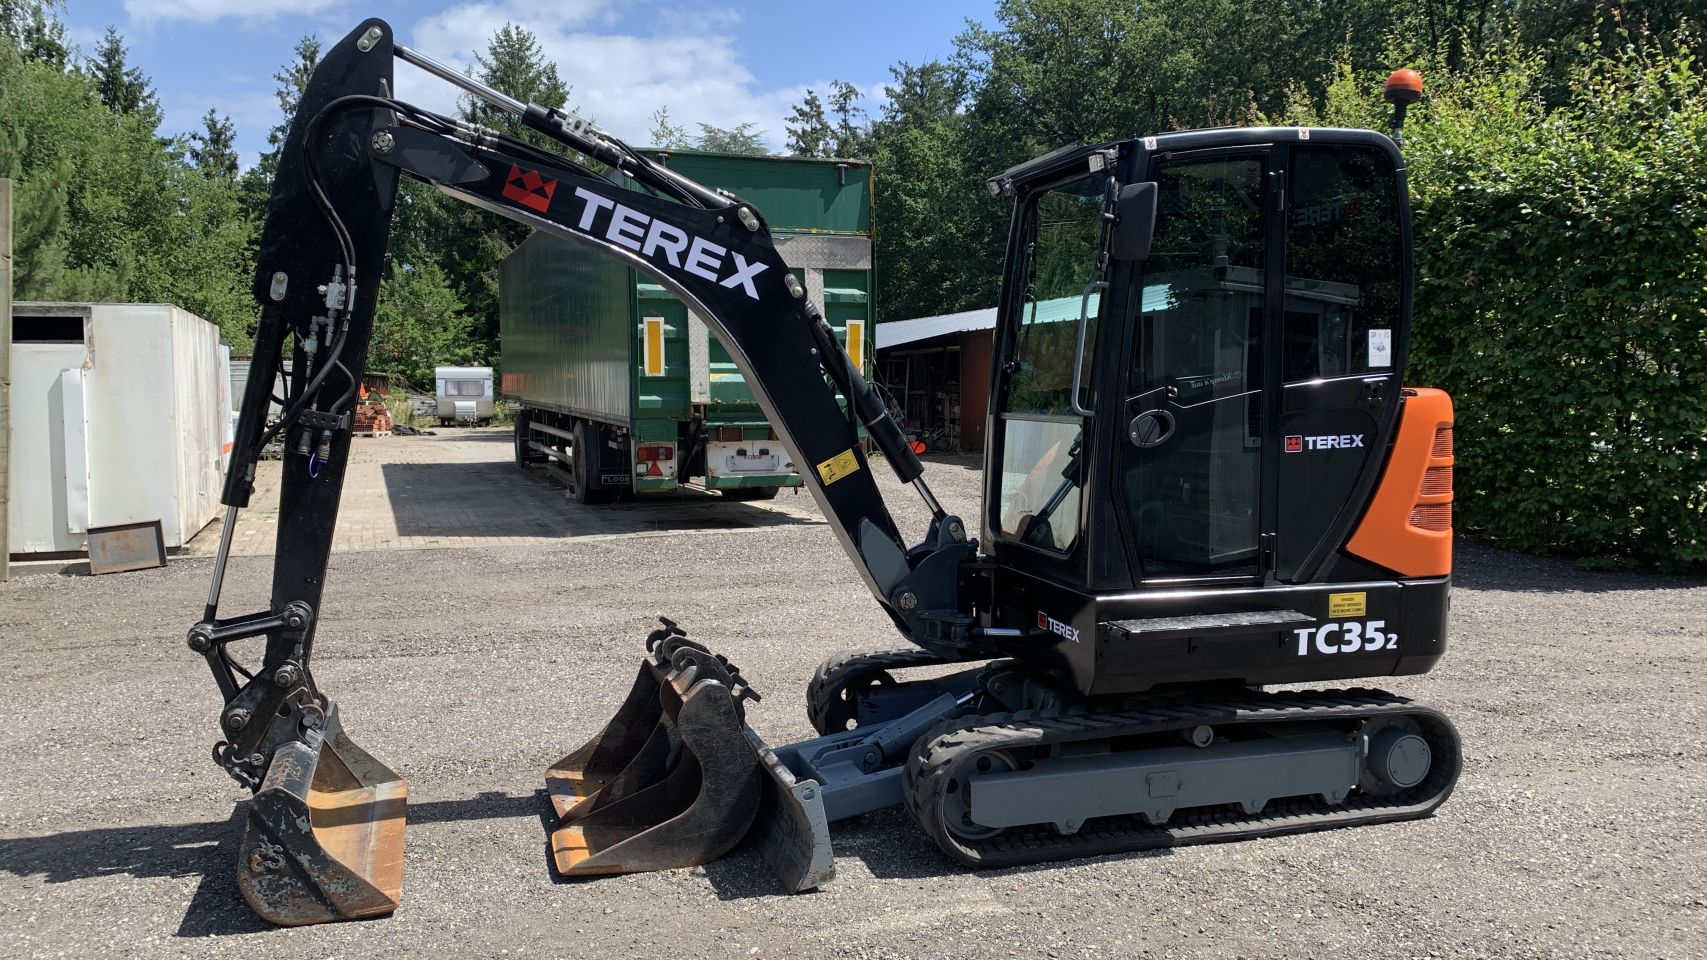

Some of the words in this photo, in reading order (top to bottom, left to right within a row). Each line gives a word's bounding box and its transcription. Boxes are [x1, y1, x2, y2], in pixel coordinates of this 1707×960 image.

[575, 186, 769, 300] TEREX
[1305, 434, 1364, 450] TEREX
[602, 476, 630, 484] FLOOR
[1048, 617, 1080, 643] TEREX
